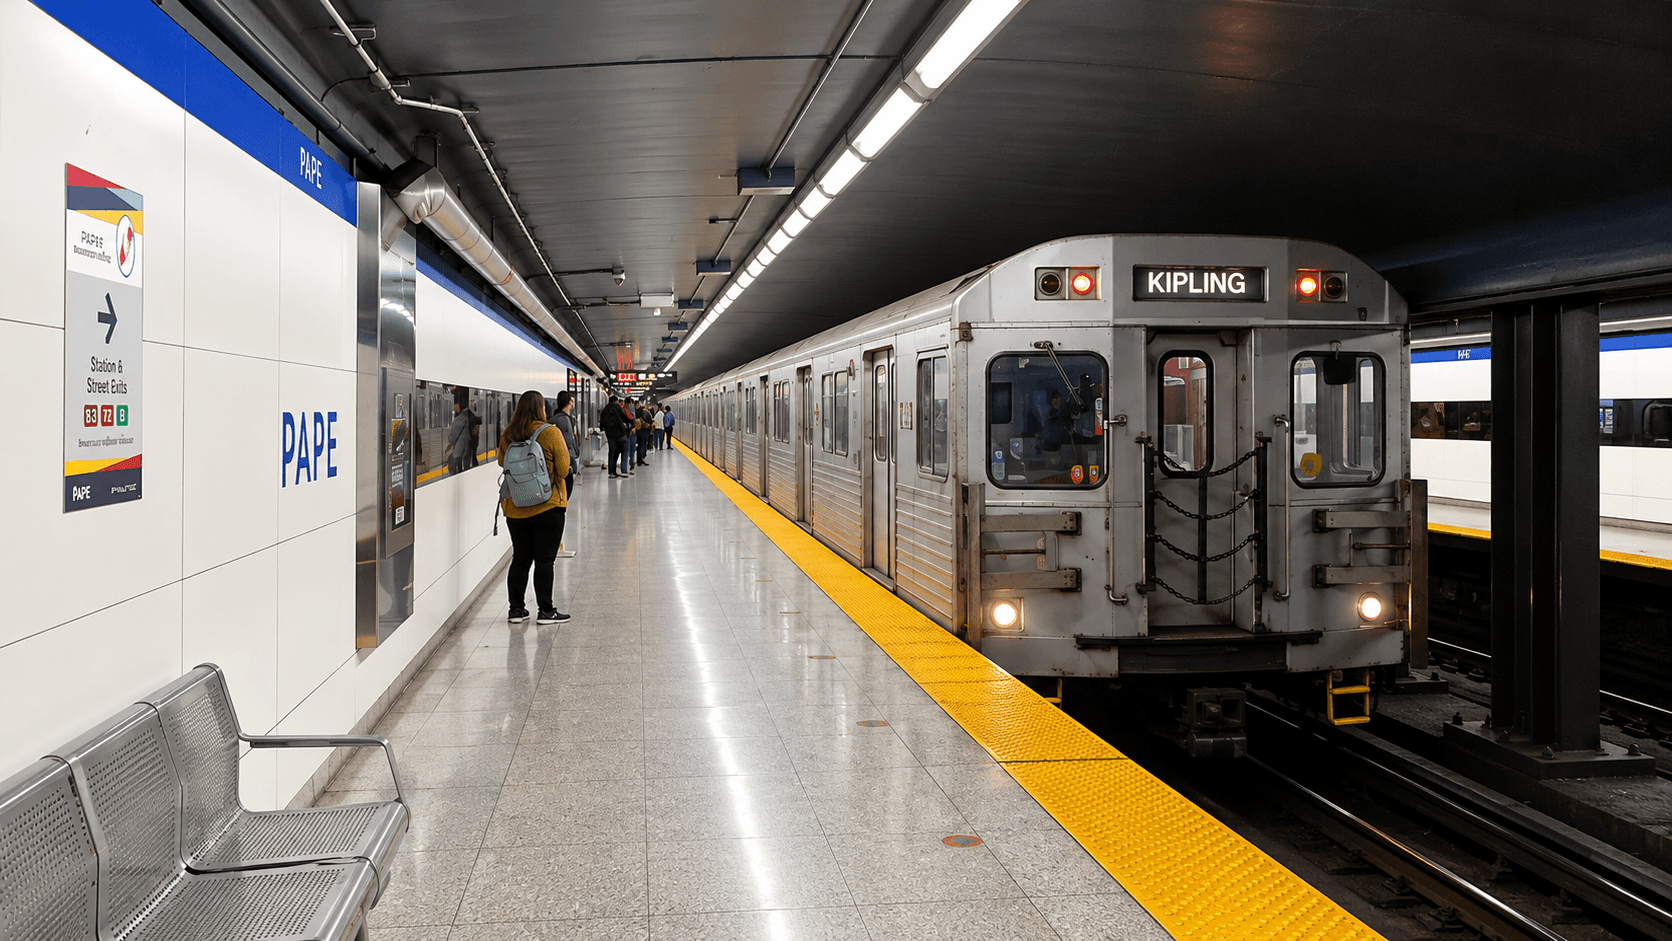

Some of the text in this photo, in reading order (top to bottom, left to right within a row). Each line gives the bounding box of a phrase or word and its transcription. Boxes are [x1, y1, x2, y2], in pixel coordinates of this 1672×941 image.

[300, 146, 323, 190] PAPE
[1148, 271, 1246, 294] KIPLING
[90, 355, 117, 374] Station
[86, 376, 110, 394] Street
[85, 408, 97, 424] 83
[102, 408, 113, 423] 72
[282, 411, 337, 488] PAPE
[72, 485, 91, 502] PAPE
